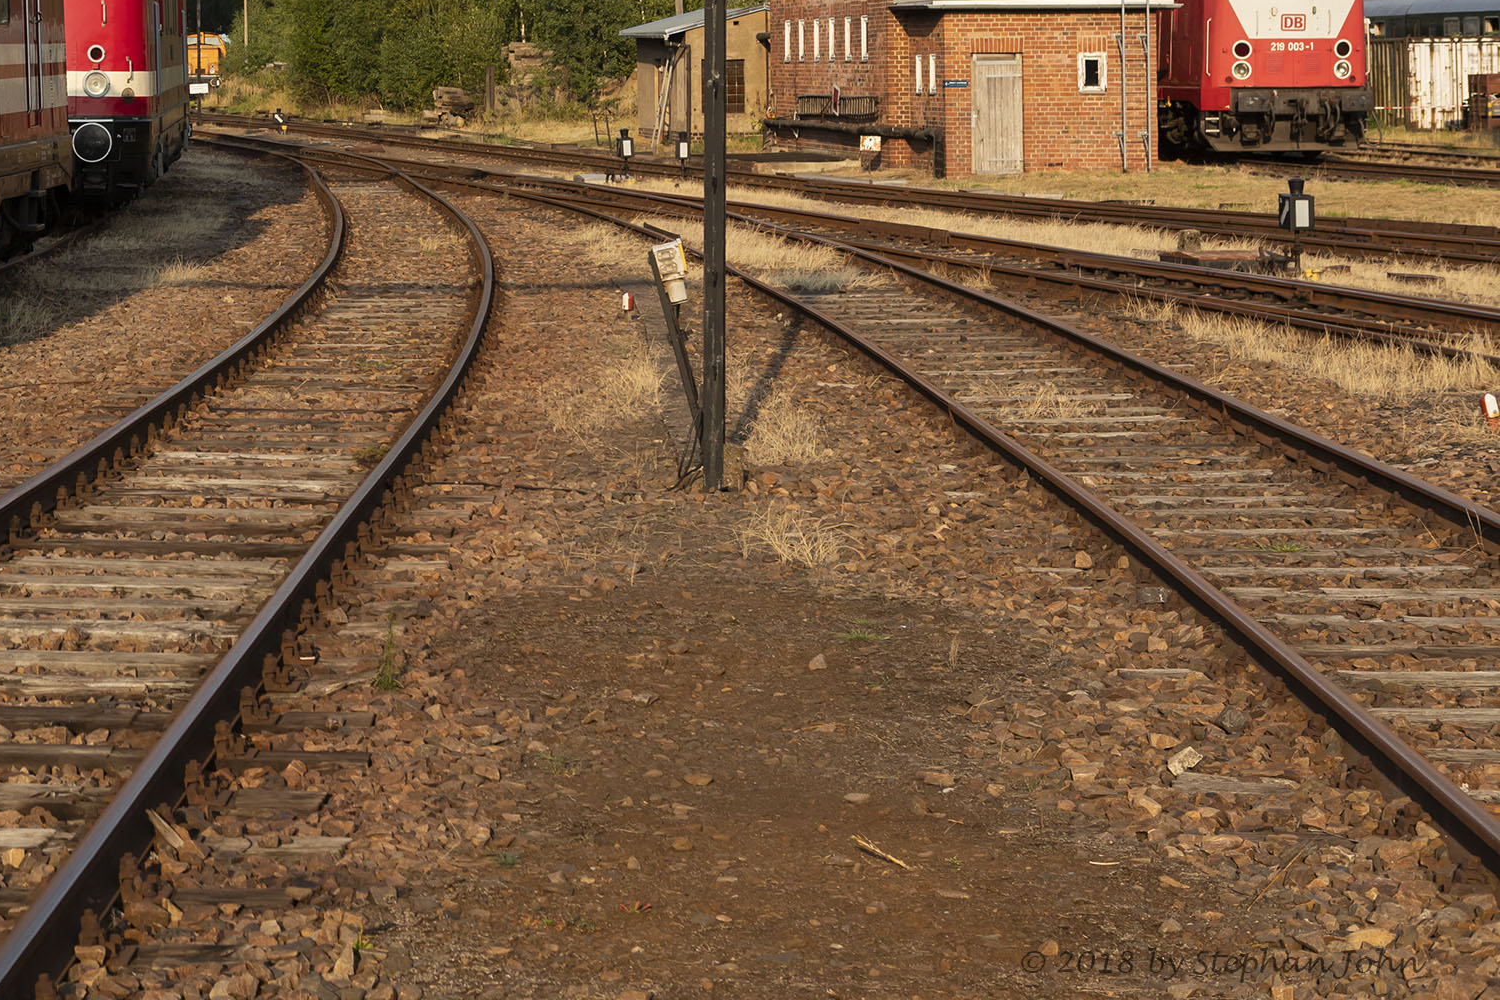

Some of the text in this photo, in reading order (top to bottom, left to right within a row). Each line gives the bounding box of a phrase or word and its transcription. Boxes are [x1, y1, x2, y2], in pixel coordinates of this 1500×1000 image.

[1283, 16, 1304, 29] DB
[1270, 41, 1314, 52] 219 003-1
